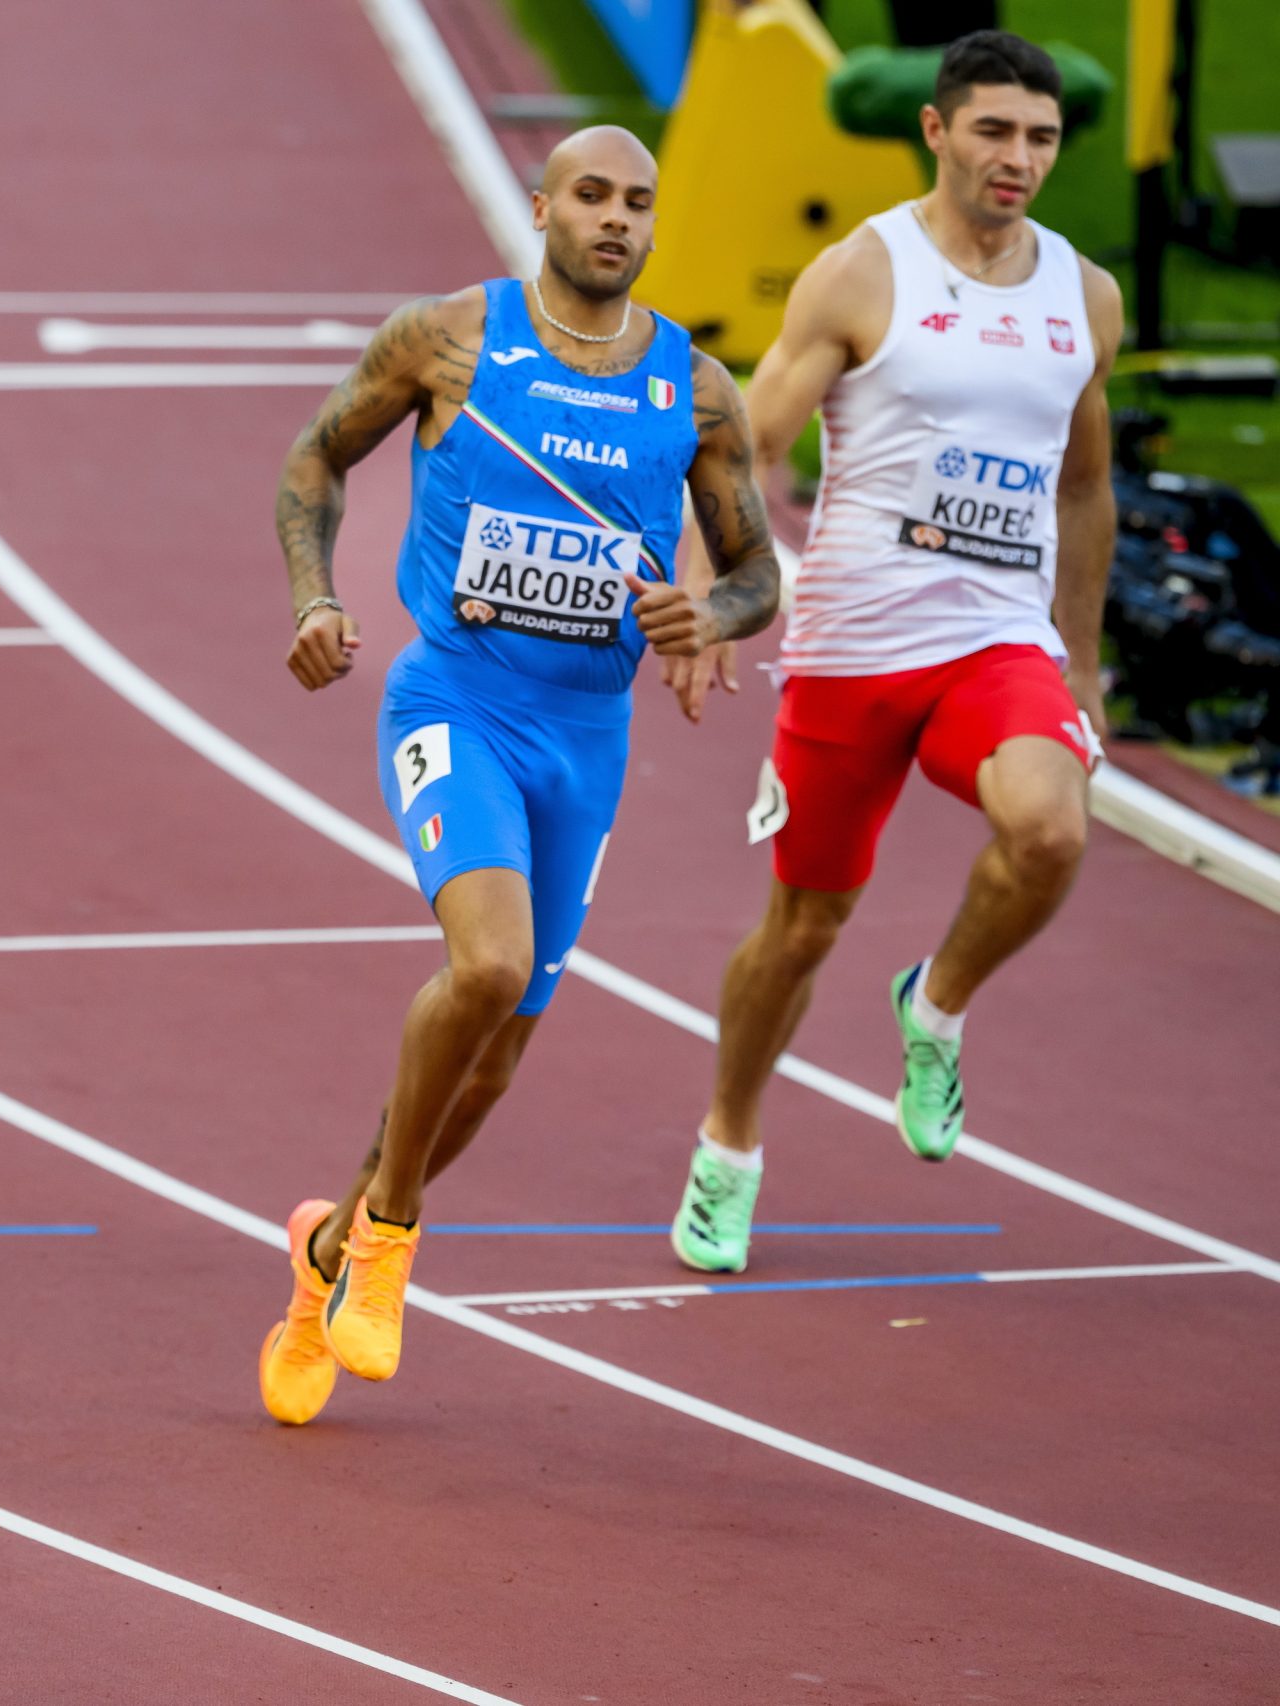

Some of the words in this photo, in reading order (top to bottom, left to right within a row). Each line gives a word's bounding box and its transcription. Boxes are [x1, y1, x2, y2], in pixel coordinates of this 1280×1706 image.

[541, 432, 629, 469] ITALIA
[972, 451, 1053, 496] TDK
[515, 521, 626, 571] TDK
[468, 559, 620, 612] JACOBS
[500, 610, 591, 637] BUDAPEST
[590, 624, 609, 638] 23
[407, 743, 427, 786] 3
